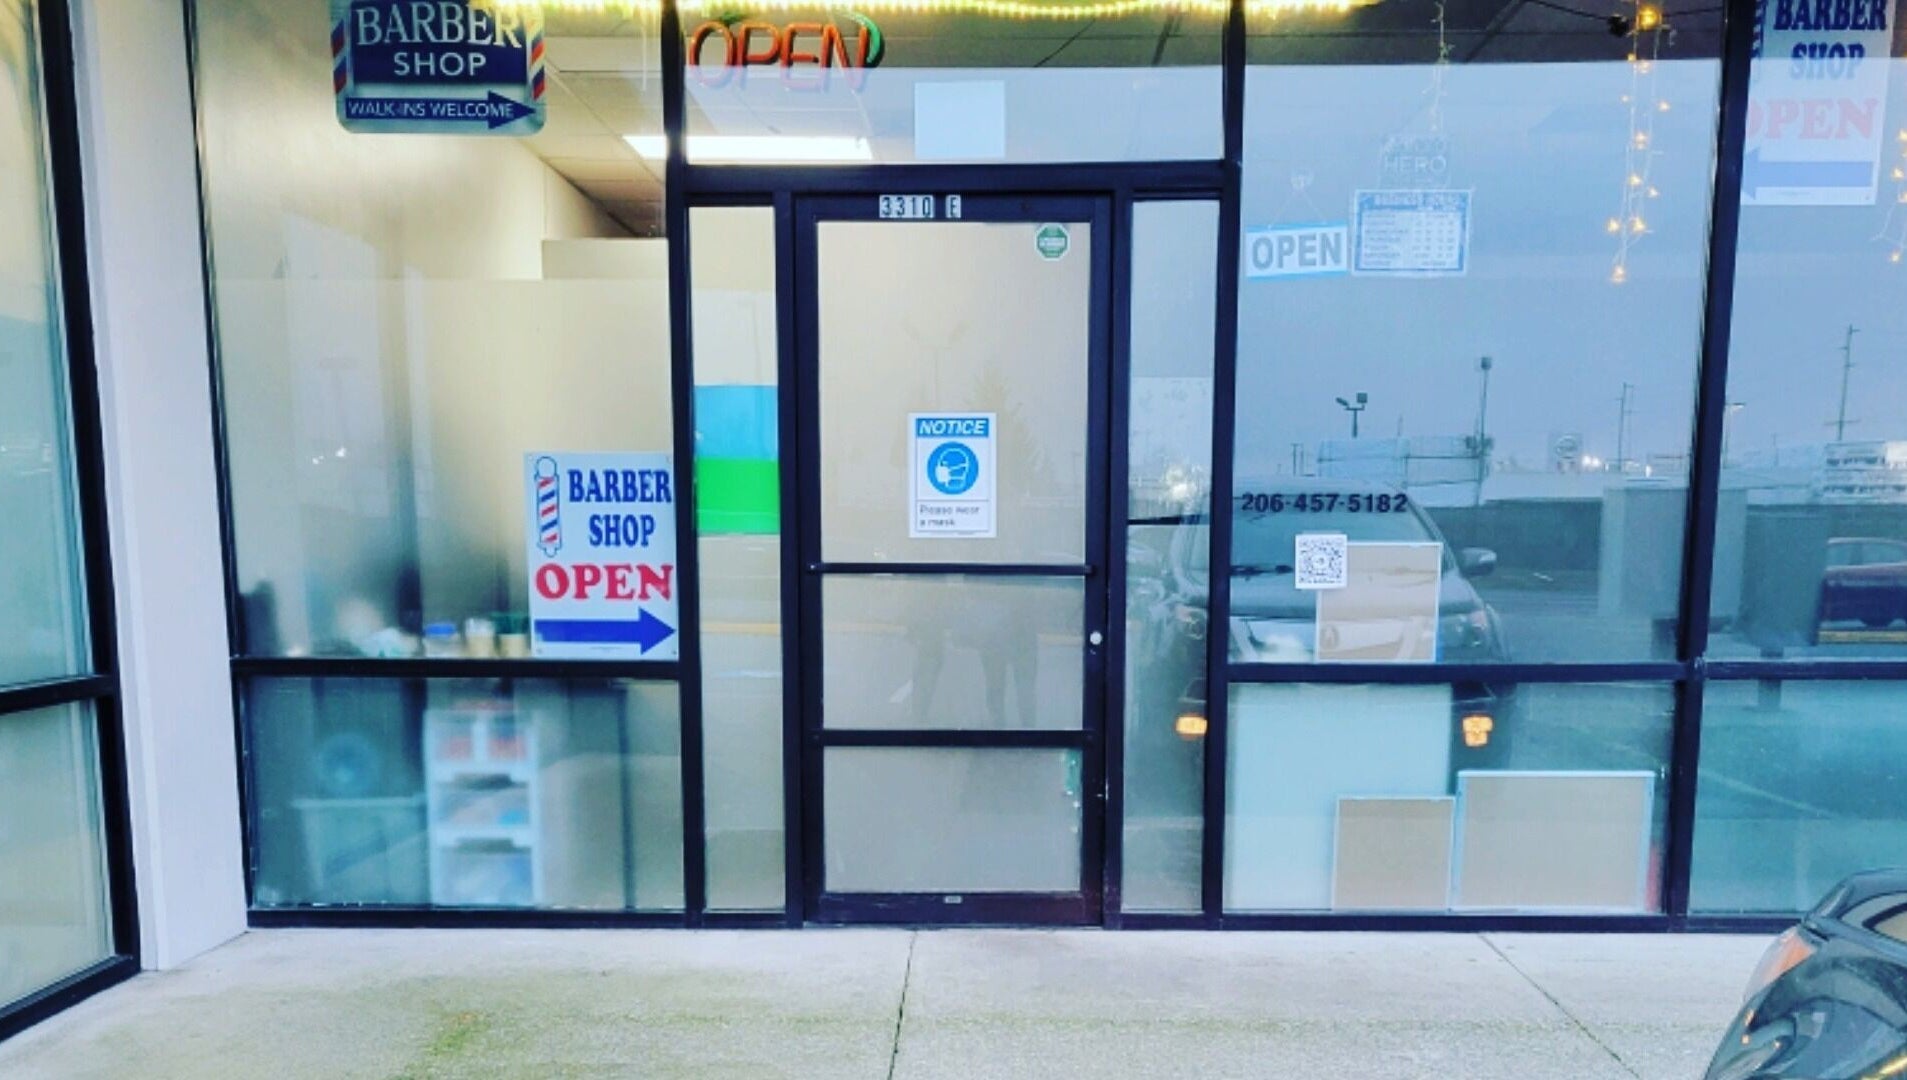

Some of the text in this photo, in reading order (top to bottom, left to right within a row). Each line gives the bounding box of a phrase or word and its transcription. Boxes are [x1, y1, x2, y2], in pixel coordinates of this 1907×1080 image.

[356, 1, 522, 48] BARBER
[1773, 0, 1887, 31] BARBER
[393, 51, 487, 77] SHOP
[690, 20, 866, 94] OPEN
[1790, 42, 1866, 79] SHOP
[429, 102, 515, 119] WELCOME
[1384, 154, 1447, 173] HERO
[881, 196, 932, 216] 3310
[1252, 232, 1342, 270] OPEN
[919, 420, 986, 435] NOTICE
[567, 469, 672, 503] BARBER
[919, 504, 953, 515] Please
[1241, 492, 1408, 513] 206-457-5182
[589, 514, 656, 547] SHOP
[535, 562, 674, 601] OPEN
